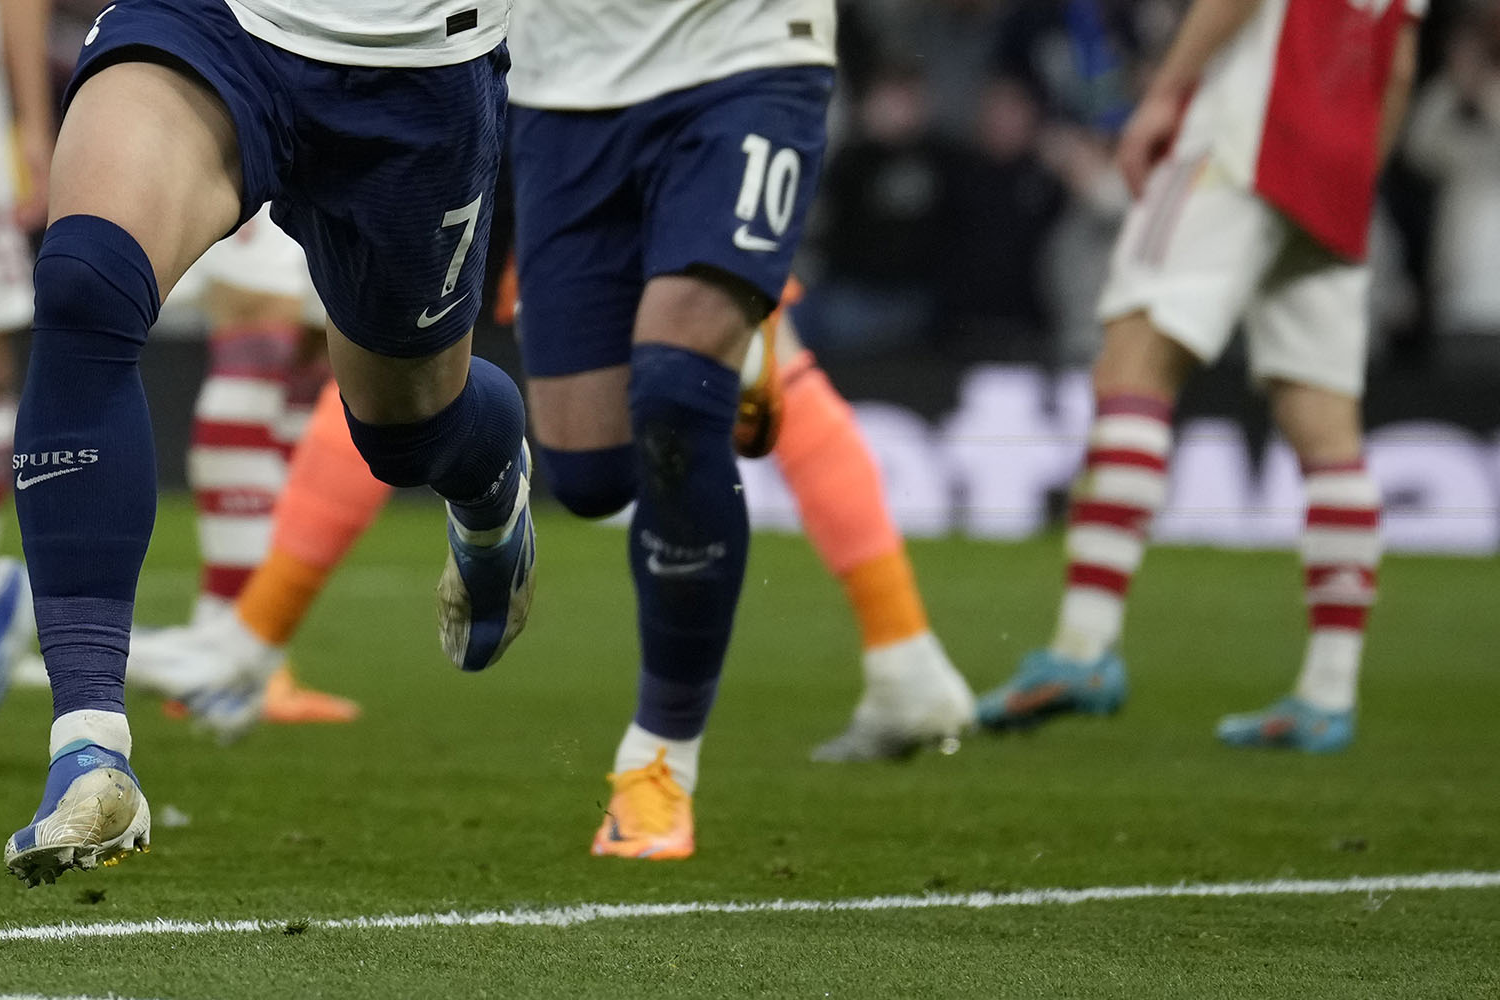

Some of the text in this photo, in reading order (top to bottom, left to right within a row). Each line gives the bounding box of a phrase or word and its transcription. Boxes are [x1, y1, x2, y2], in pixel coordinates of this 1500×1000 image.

[735, 133, 800, 236] 10
[441, 192, 482, 297] 7
[12, 448, 99, 470] SPURS
